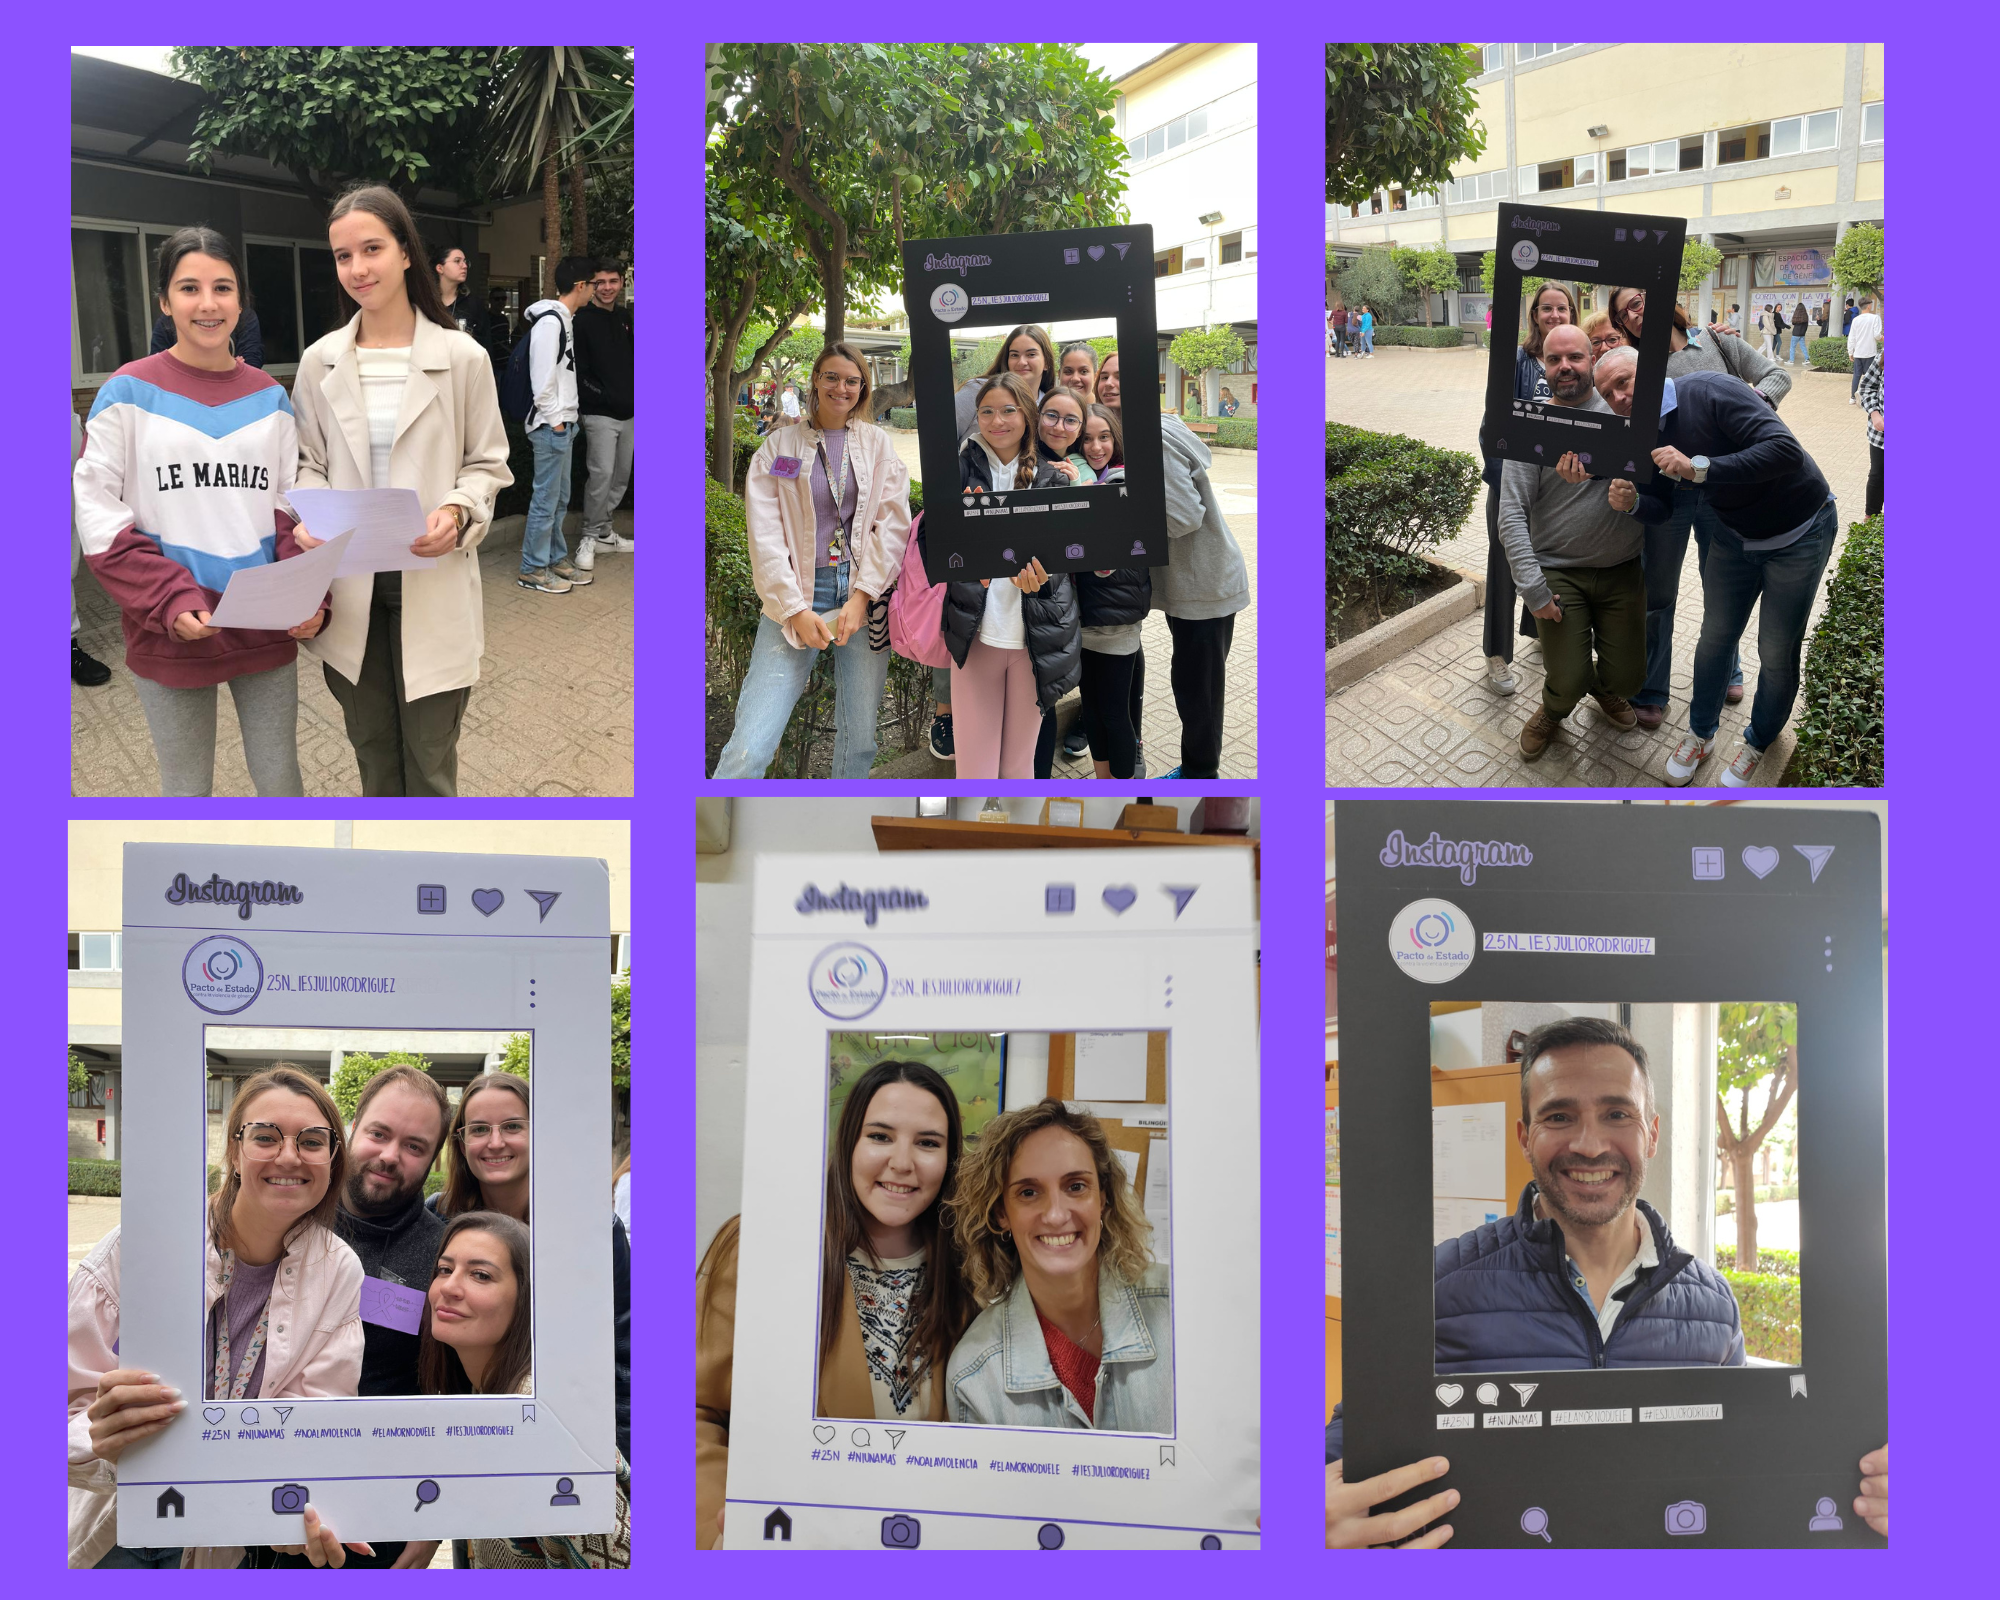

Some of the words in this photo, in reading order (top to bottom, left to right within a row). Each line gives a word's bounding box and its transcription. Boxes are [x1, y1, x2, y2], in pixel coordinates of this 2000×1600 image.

[924, 253, 992, 277] Instagram
[1790, 262, 1828, 271] VIOLENCIA
[1793, 271, 1823, 280] GÉNERO
[156, 463, 184, 492] LE
[192, 462, 269, 491] MARAIS
[1380, 830, 1533, 886] Instagram
[165, 872, 304, 921] Instagram
[795, 881, 930, 928] Instagram
[1396, 951, 1425, 960] Pacto
[1435, 951, 1470, 960] Estado
[190, 983, 215, 992] Pacto
[224, 984, 255, 993] Estado
[266, 974, 396, 994] 25N_IESJULIORODRIGUEZ
[1442, 1416, 1470, 1428] #25N
[1487, 1412, 1539, 1426] #NIUNAMAS
[1554, 1410, 1628, 1423] #ELAMORNODUELE
[1643, 1406, 1720, 1419] #IESJULIORODRIGUEZ
[202, 1429, 231, 1441] #25N
[237, 1428, 286, 1440] #NIUNAMAS
[293, 1427, 362, 1439] #NOALAVIOLENCIA
[371, 1426, 436, 1438] #ELAMORNODUELE
[445, 1425, 514, 1437] #IESJULIORODRIGUEZ
[811, 1449, 841, 1461] #25N
[847, 1451, 897, 1466] #NIUNAMAS
[905, 1454, 979, 1470] #NOALAVIOLENCIA
[989, 1459, 1061, 1475] #ELAMORNODUELE
[1071, 1464, 1151, 1481] #IESJULIORODRIGUEZ
